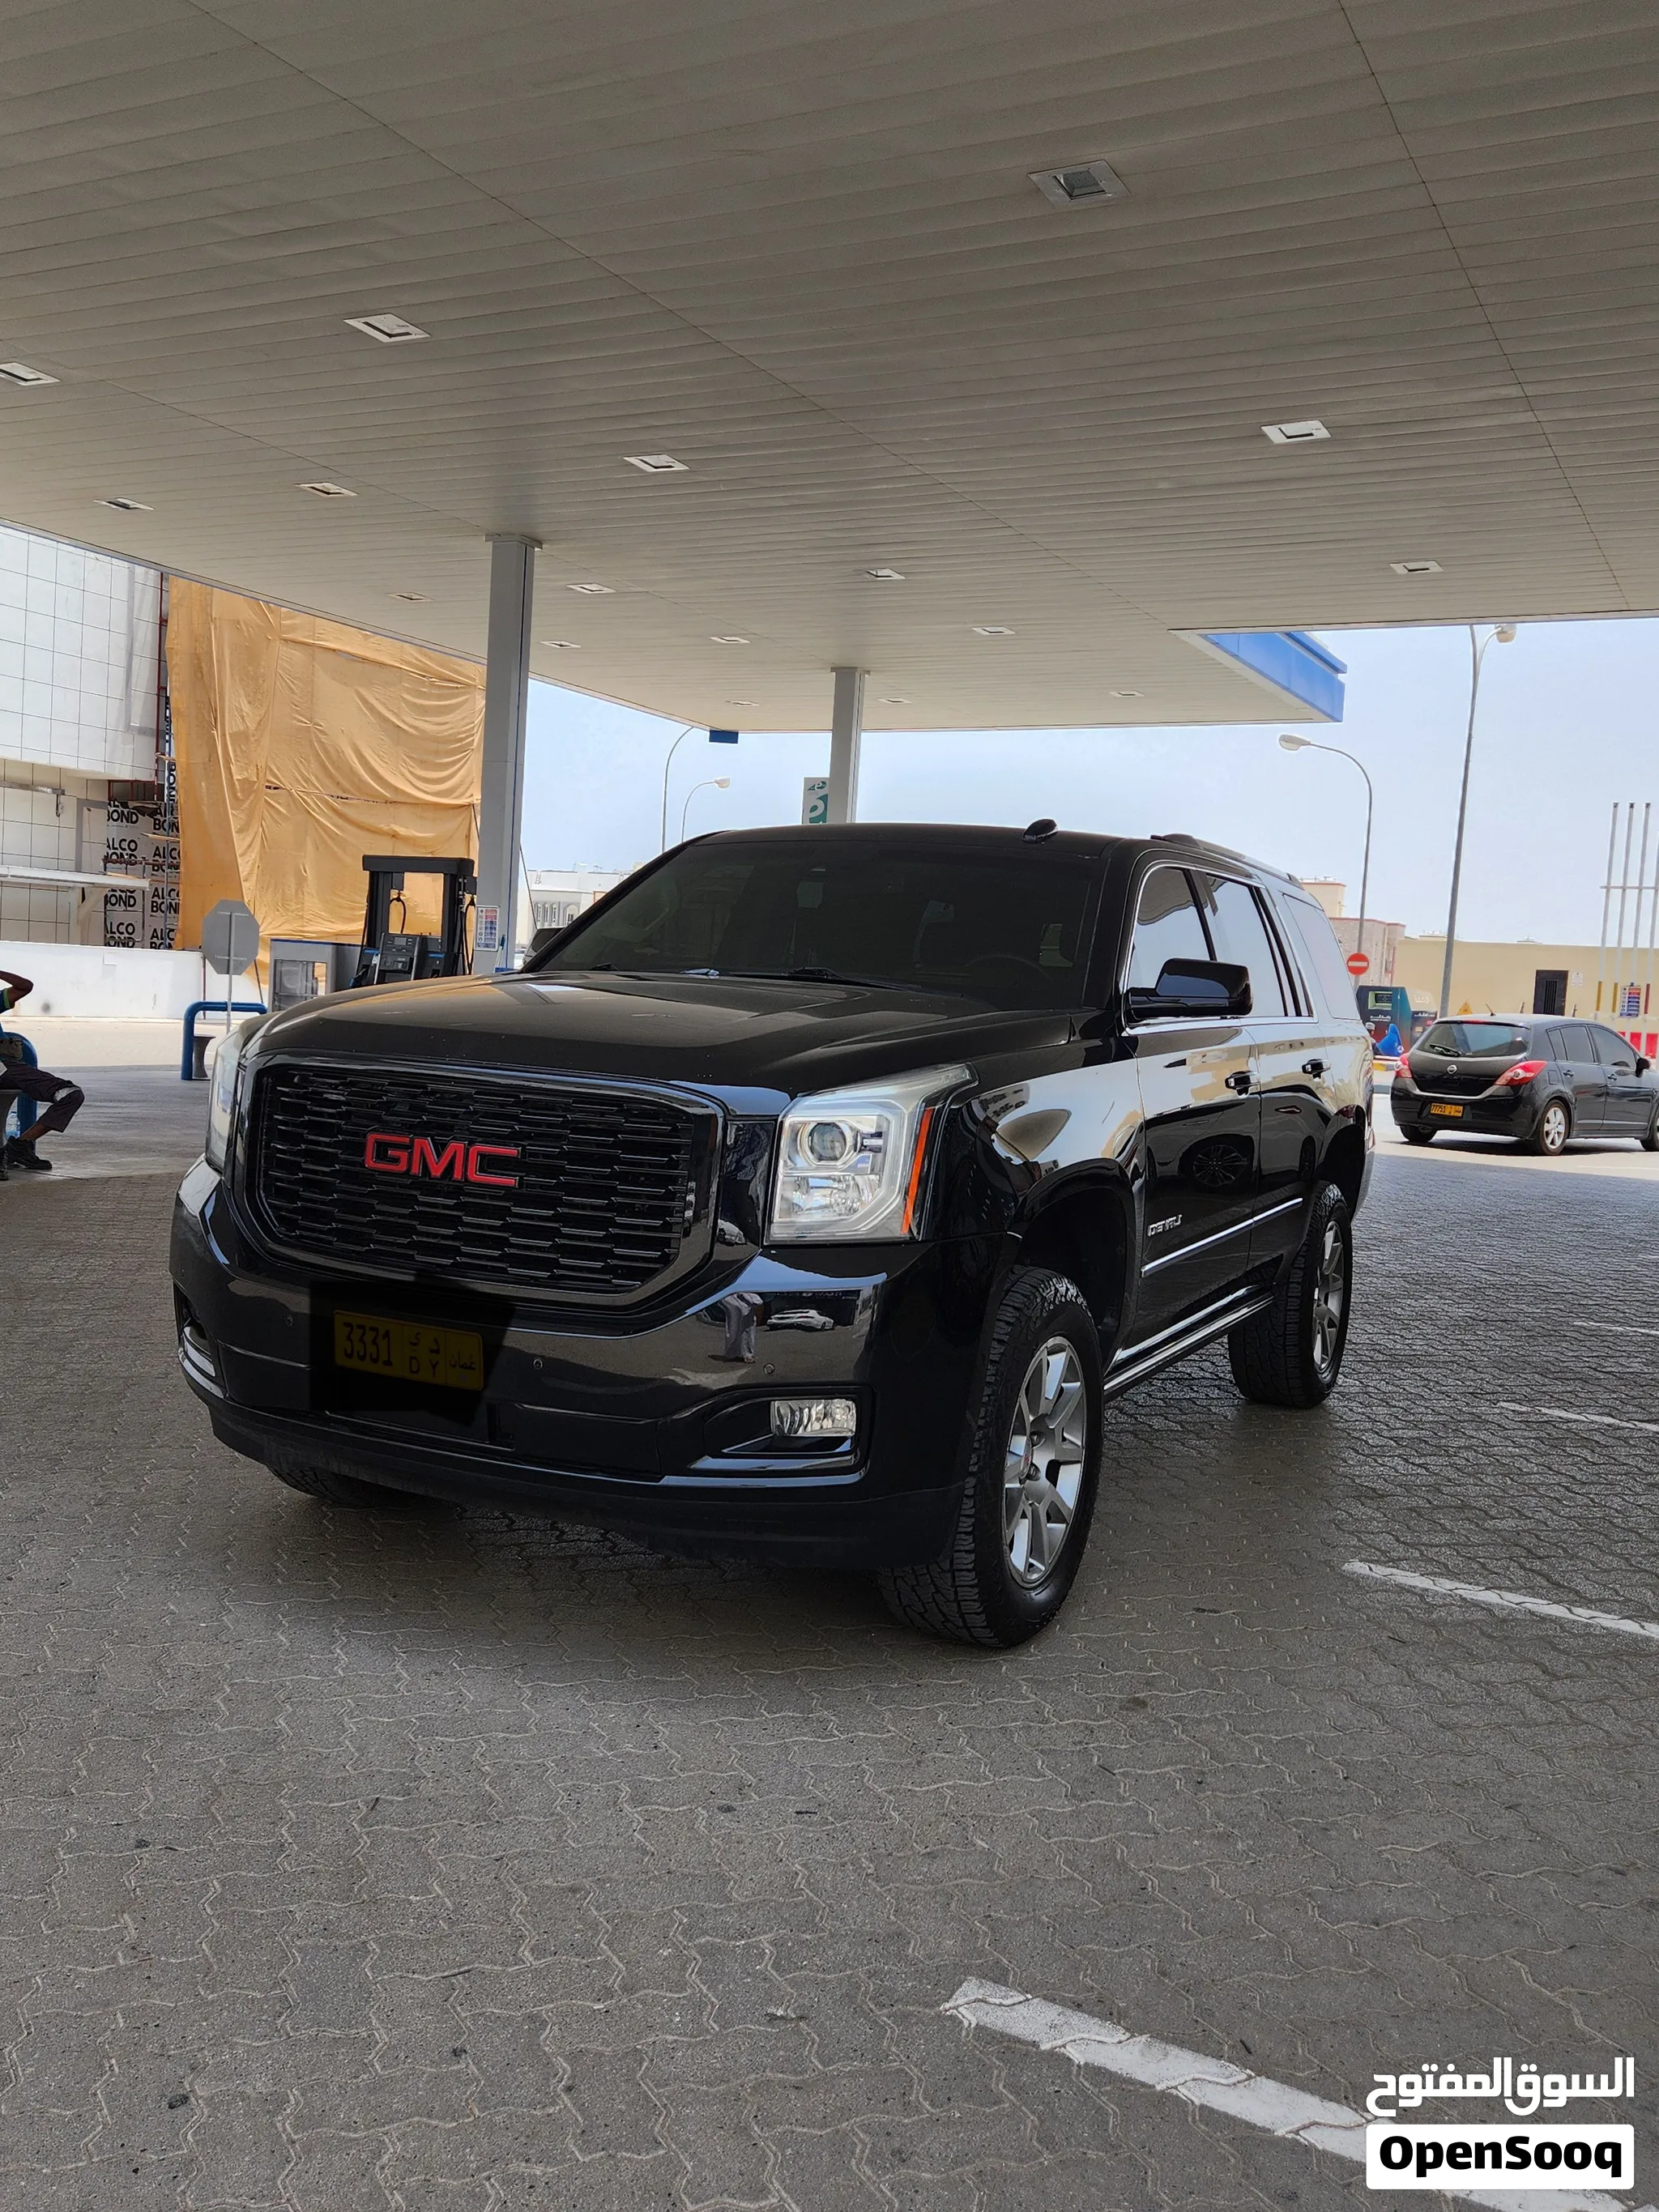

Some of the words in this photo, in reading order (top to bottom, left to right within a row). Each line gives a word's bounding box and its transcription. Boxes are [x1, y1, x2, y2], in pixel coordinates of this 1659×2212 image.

[153, 818, 179, 833] BON
[153, 846, 180, 860] ALC
[107, 893, 136, 907] OND
[151, 887, 180, 901] ALC
[151, 900, 180, 914] BON
[150, 928, 176, 941] ALC
[107, 936, 135, 948] OND
[365, 1132, 522, 1187] GMC
[343, 1322, 393, 1366] 3331
[409, 1356, 420, 1374] D
[429, 1358, 439, 1377] Y
